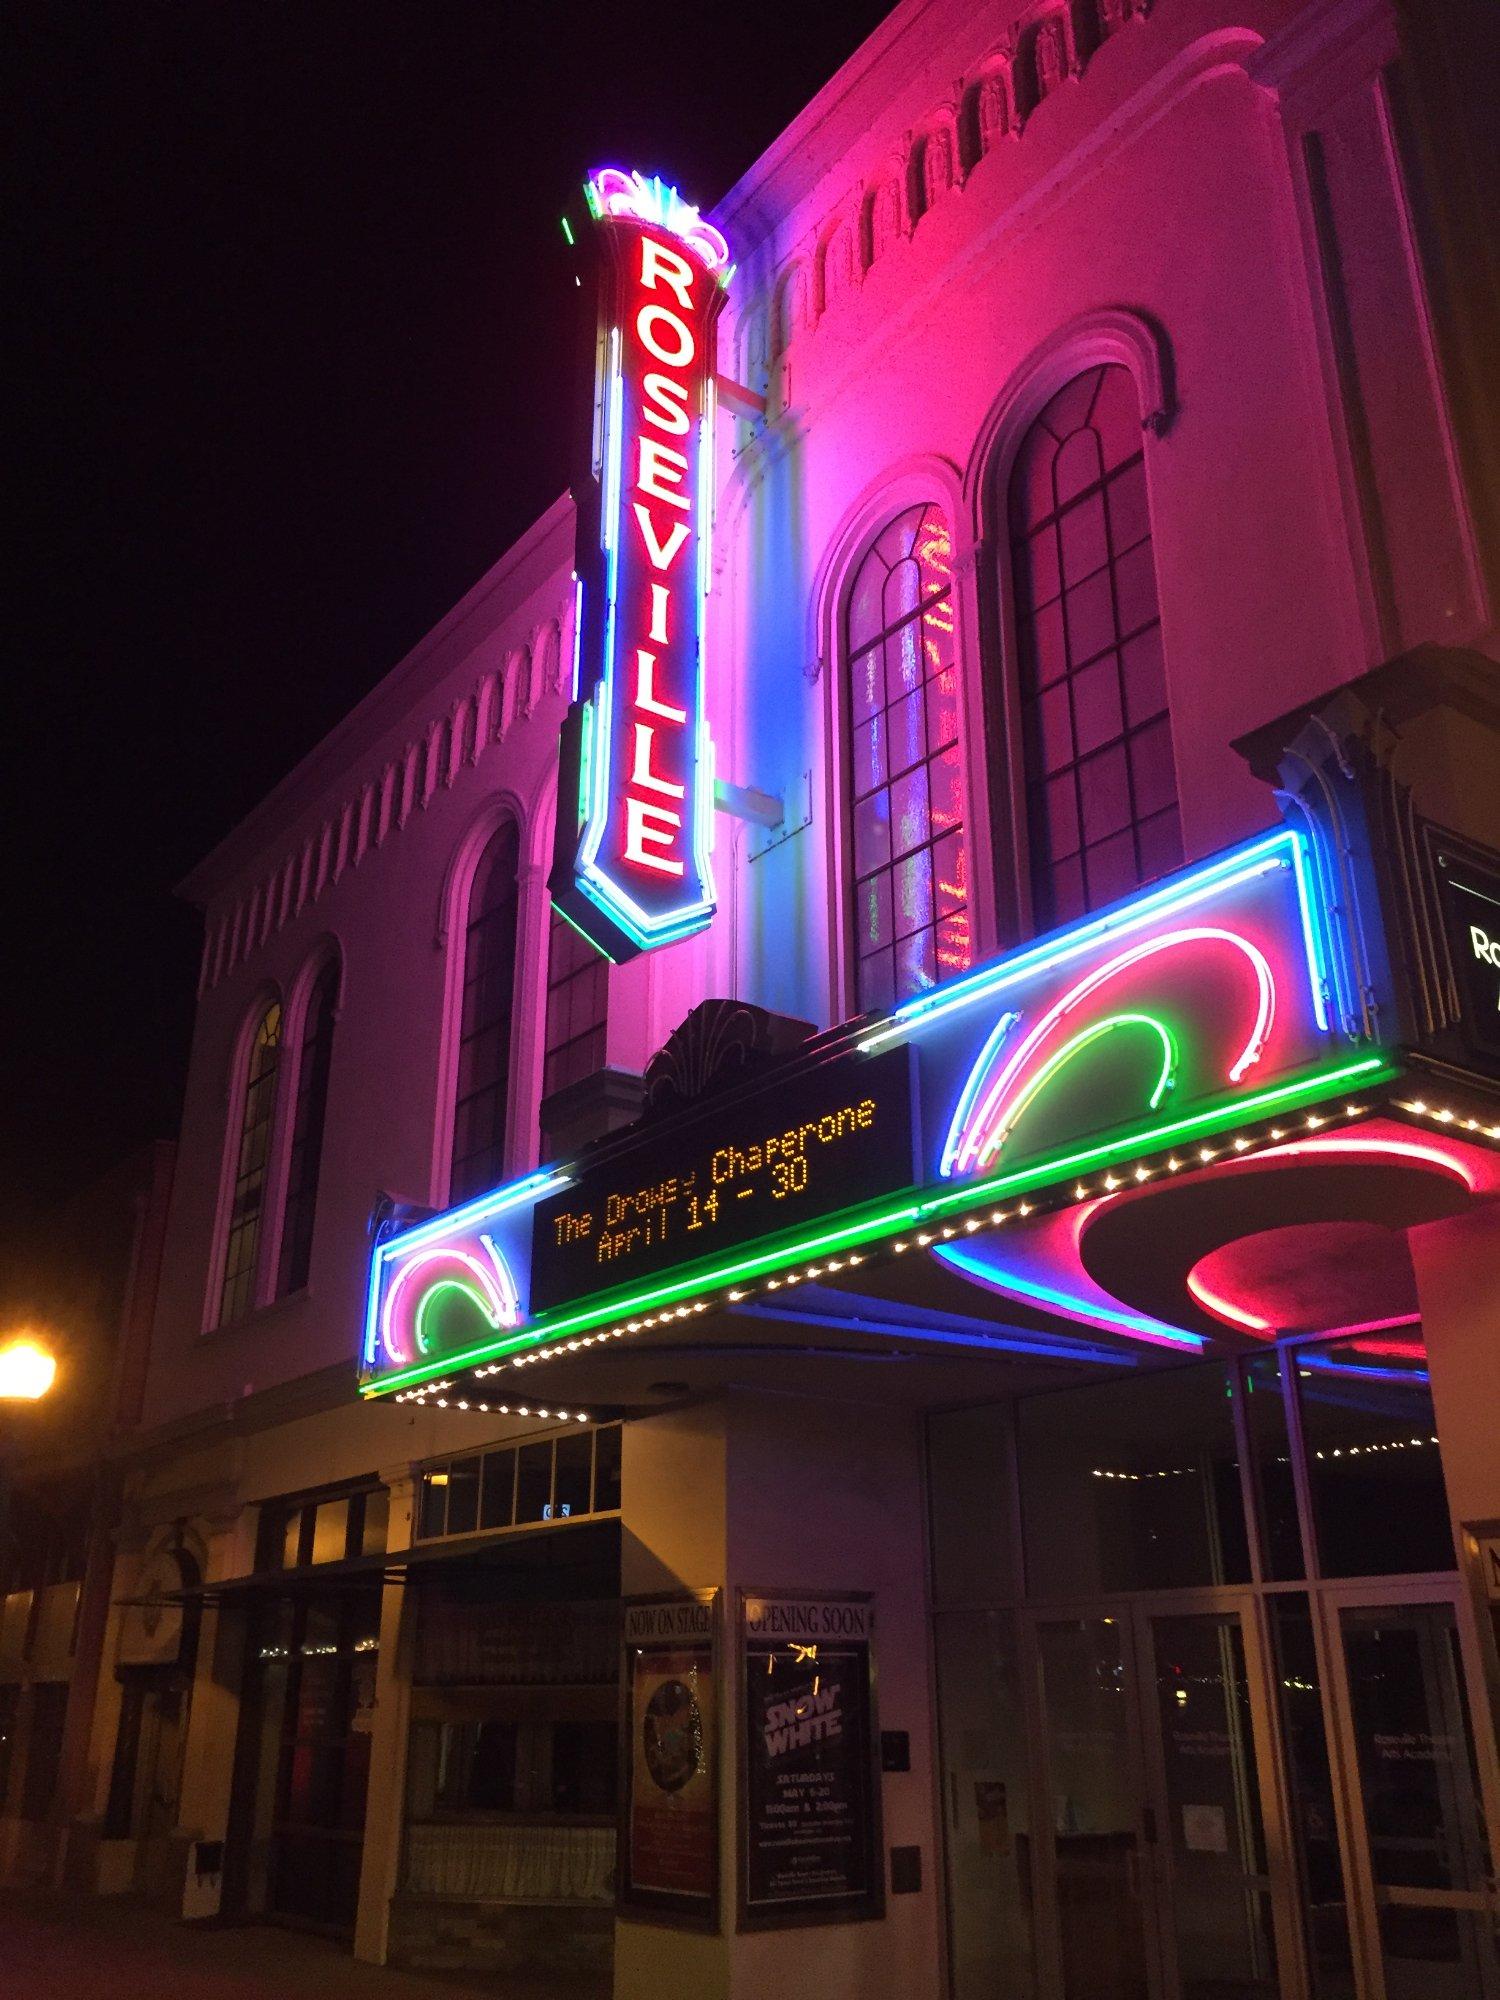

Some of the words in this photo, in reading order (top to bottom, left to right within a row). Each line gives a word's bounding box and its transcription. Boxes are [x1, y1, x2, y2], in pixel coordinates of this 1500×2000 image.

[624, 236, 695, 876] ROSEVILLE
[554, 1212, 593, 1246] The
[712, 1099, 876, 1184] Chaperone
[598, 1207, 667, 1263] April
[686, 1188, 719, 1231] 14
[771, 1155, 807, 1199] 30
[630, 1608, 657, 1637] NOW
[657, 1608, 674, 1634] ON
[677, 1605, 712, 1634] STAGE
[750, 1605, 818, 1633] OPENING
[822, 1606, 865, 1634] SOON
[764, 1683, 841, 1733] SNOW
[764, 1708, 843, 1758] WHITE
